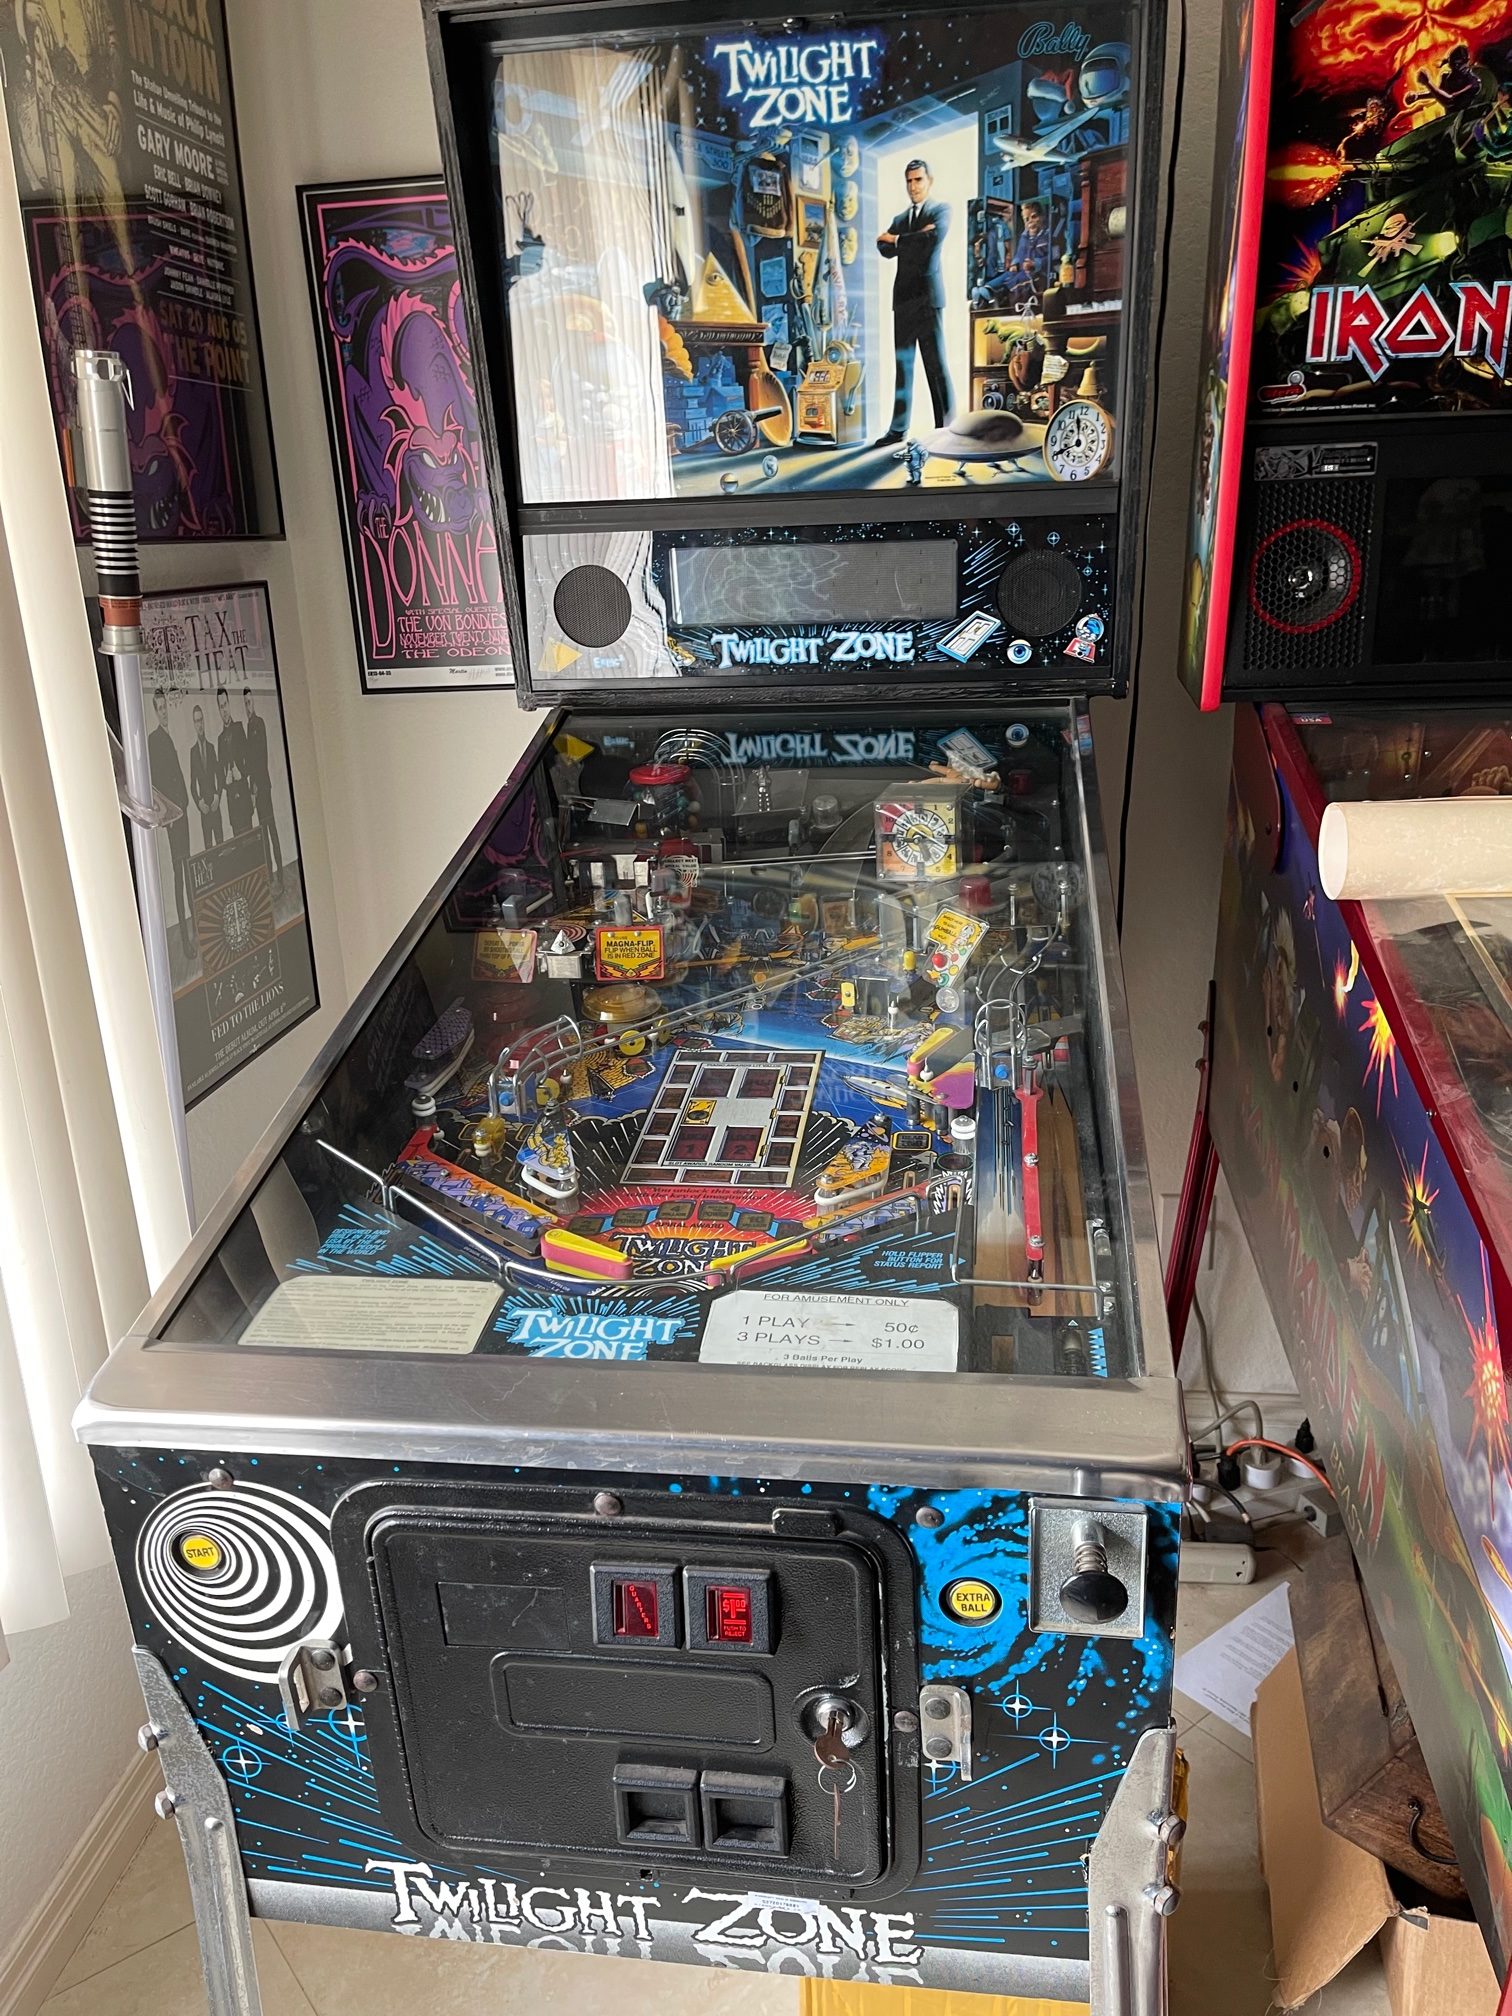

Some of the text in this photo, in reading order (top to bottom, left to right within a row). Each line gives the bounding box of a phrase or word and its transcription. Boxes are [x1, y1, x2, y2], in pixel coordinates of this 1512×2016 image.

[1018, 21, 1092, 61] Bally
[131, 69, 143, 87] The
[713, 40, 878, 98] TWILIGHT
[156, 101, 177, 124] Music
[743, 83, 853, 128] ZONE
[137, 123, 171, 161] GARY
[174, 139, 215, 180] MOORE
[153, 163, 167, 183] ERIC
[167, 168, 182, 189] BELL
[144, 183, 162, 204] SCOTT
[1305, 281, 1512, 384] IRON
[201, 340, 251, 384] POINT
[360, 519, 504, 660] DONNA
[184, 610, 247, 653] TAX THE
[397, 612, 509, 633] THE VON BONDIES
[399, 631, 447, 646] NOVEMBER
[449, 629, 486, 643] TWENTY
[401, 646, 512, 660] THE ODEON
[711, 631, 915, 669] TWILIGHT ZONE
[195, 645, 249, 689] HEAT
[620, 946, 640, 954] WHEN
[210, 983, 286, 1044] FED TO THE LIONS
[729, 1144, 747, 1156] 2
[613, 1233, 754, 1259] TWILIGHT
[881, 1250, 944, 1259] HOLD FLIPPER
[632, 1256, 707, 1277] ZON
[893, 1256, 943, 1265] BUTTON FOR
[907, 1262, 944, 1270] REPORT
[763, 1292, 910, 1307] FOR AMUSEMENT ONLY
[511, 1310, 682, 1342] TWILIGHT
[743, 1315, 920, 1334] 1 PLAY 50¢
[528, 1336, 646, 1361] ZONE
[736, 1331, 926, 1350] 3 PLAYS $1.00
[792, 1354, 818, 1362] Balls
[820, 1354, 839, 1363] Per
[840, 1356, 864, 1365] Play
[1330, 1440, 1365, 1546] BEAST
[185, 1546, 215, 1559] START
[628, 1584, 652, 1630] QUARTERS
[955, 1591, 993, 1603] EXTRA
[960, 1602, 990, 1613] BALL
[364, 1858, 663, 1942] TWILIGHT
[681, 1886, 925, 1966] ZONE
